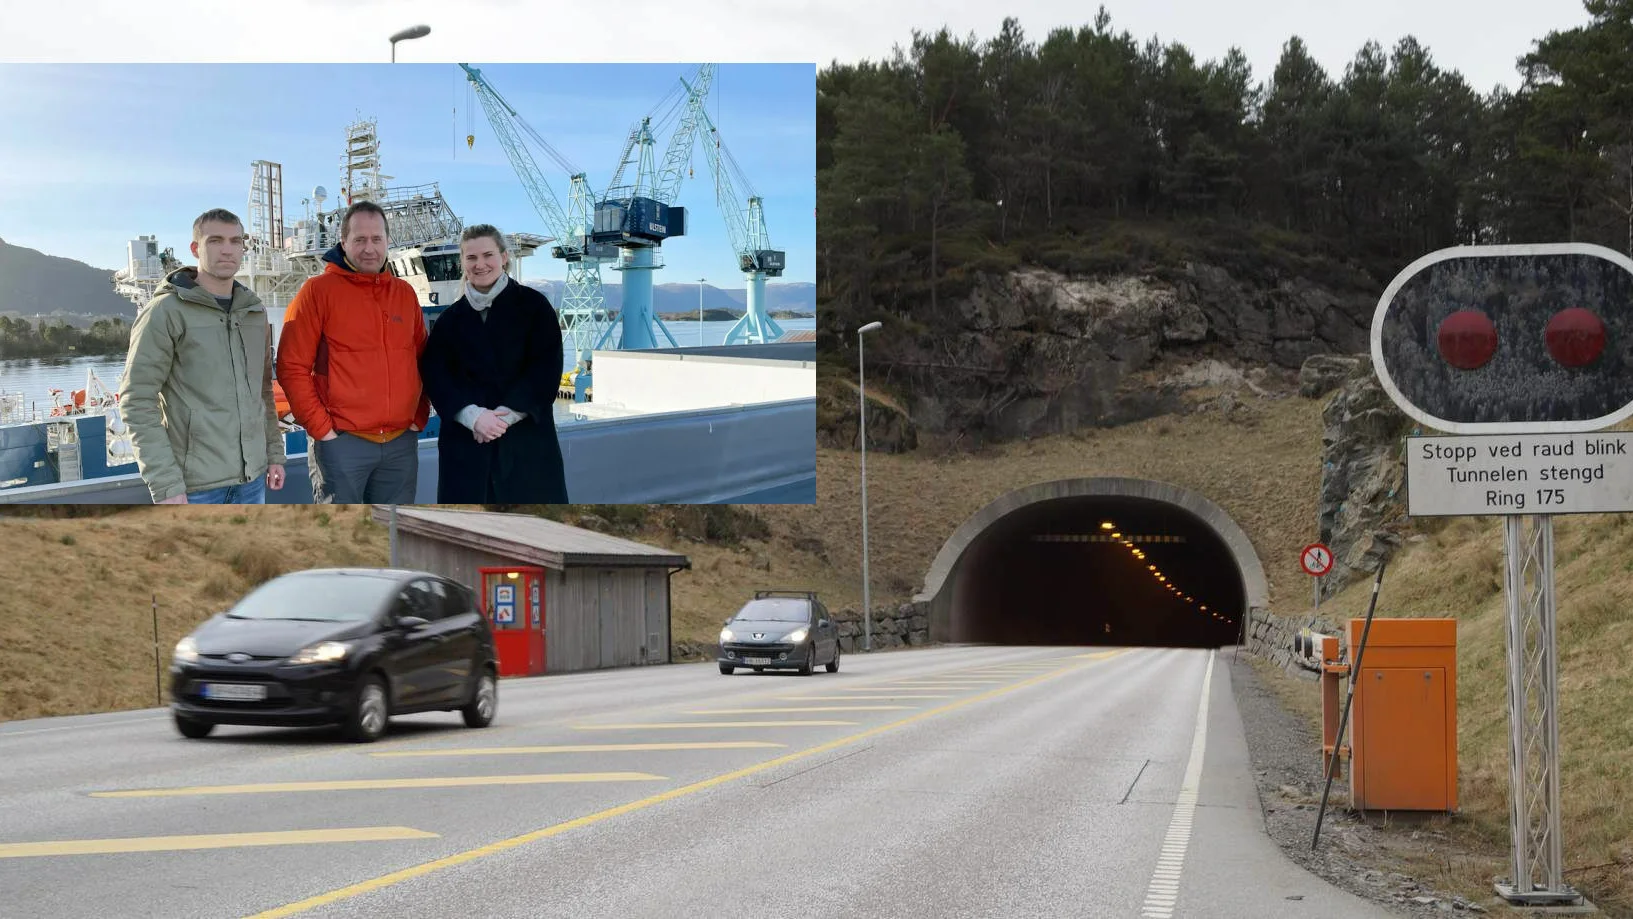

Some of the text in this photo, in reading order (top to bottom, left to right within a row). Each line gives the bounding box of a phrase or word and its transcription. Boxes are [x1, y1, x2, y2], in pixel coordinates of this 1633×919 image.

[1422, 439, 1627, 462] Stopp ved raud blink
[1446, 464, 1604, 484] Tunnelen stengd
[1486, 489, 1565, 509] Ring 175
